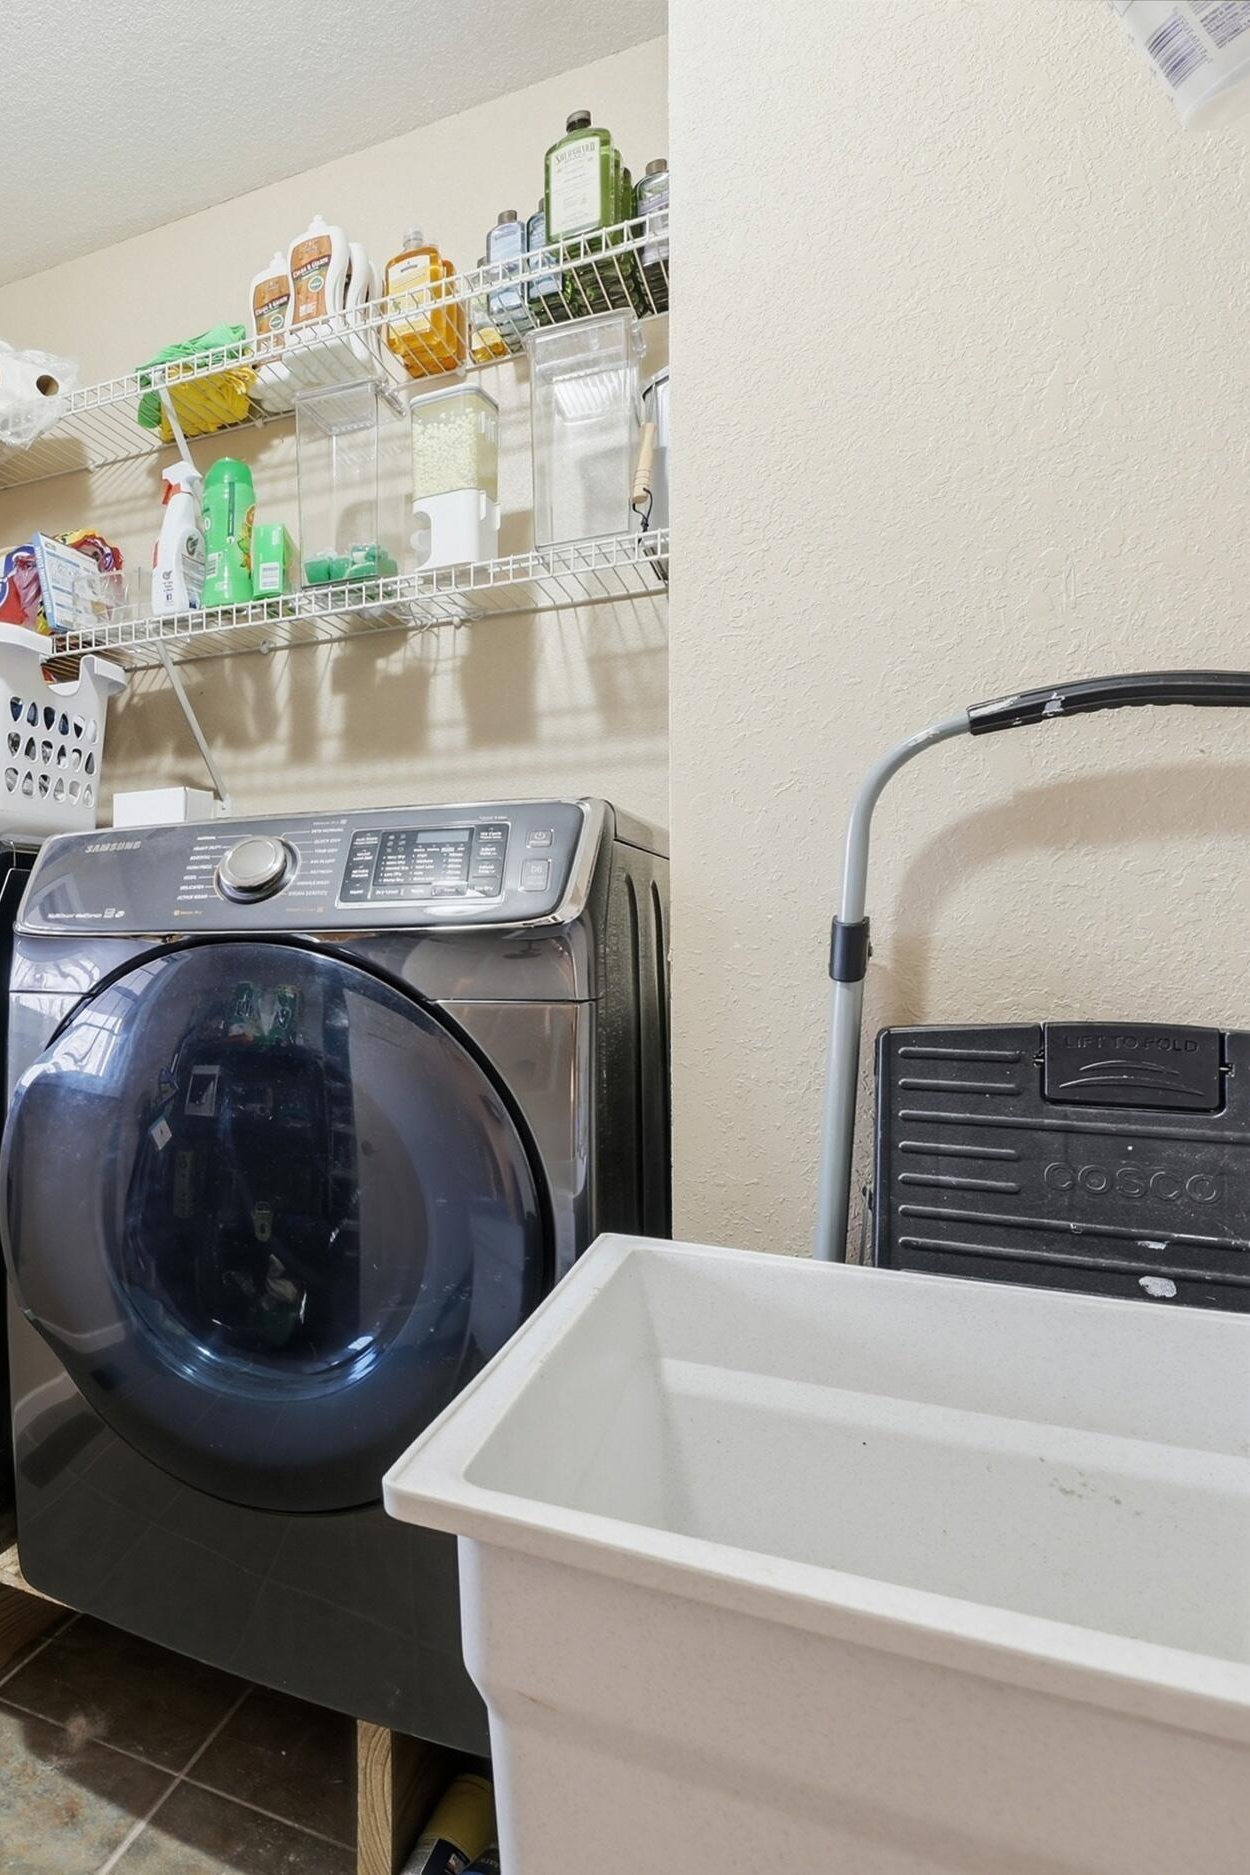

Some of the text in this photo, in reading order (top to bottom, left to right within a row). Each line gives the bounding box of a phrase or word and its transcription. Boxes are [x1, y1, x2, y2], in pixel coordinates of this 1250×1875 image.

[85, 841, 142, 854] SAMSUNG
[1064, 1034, 1199, 1053] LIFT TO FOLD
[1043, 1161, 1228, 1204] COSCO
